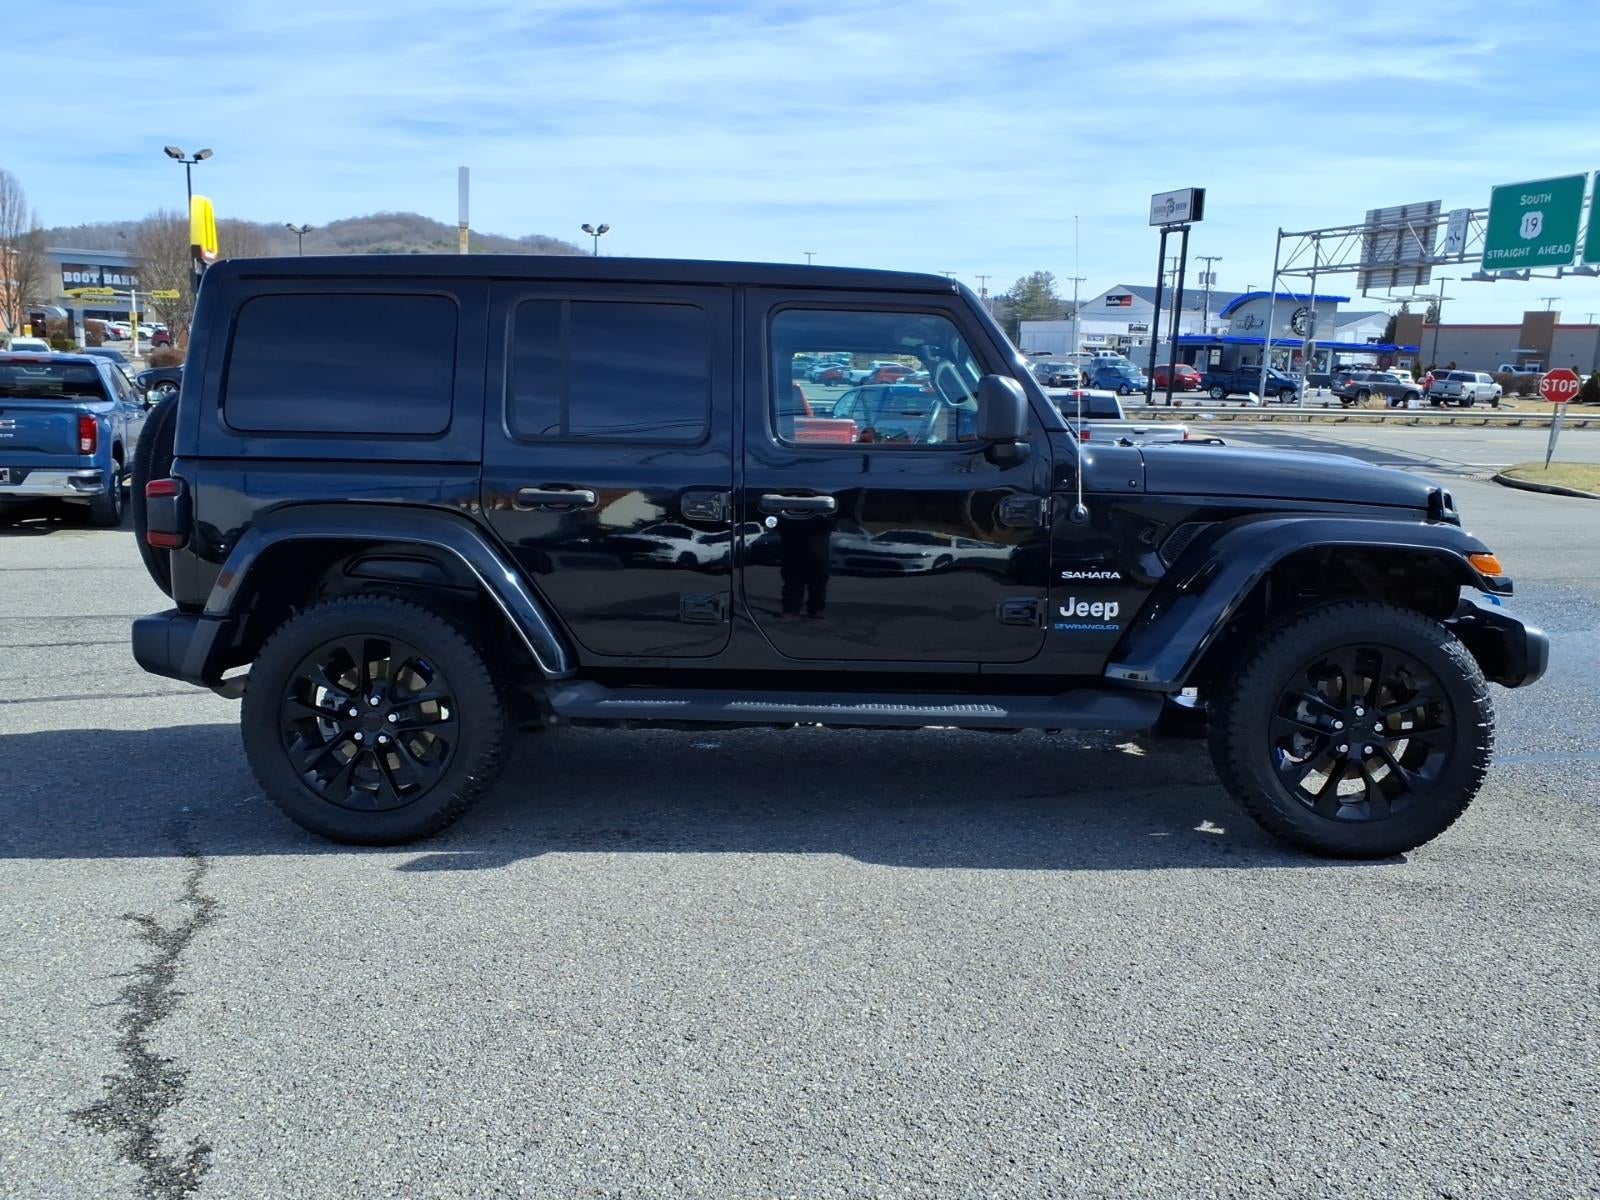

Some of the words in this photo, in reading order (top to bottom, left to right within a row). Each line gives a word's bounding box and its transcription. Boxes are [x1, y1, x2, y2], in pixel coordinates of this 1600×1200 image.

[1520, 193, 1552, 206] SOUTH
[1524, 217, 1538, 233] 19
[1487, 247, 1531, 259] STRAIGHT
[1537, 244, 1571, 256] AHEAD
[63, 271, 100, 284] BOOT
[1541, 378, 1578, 393] STOP
[1061, 571, 1121, 579] SAHARA
[1059, 596, 1119, 621] Jeep
